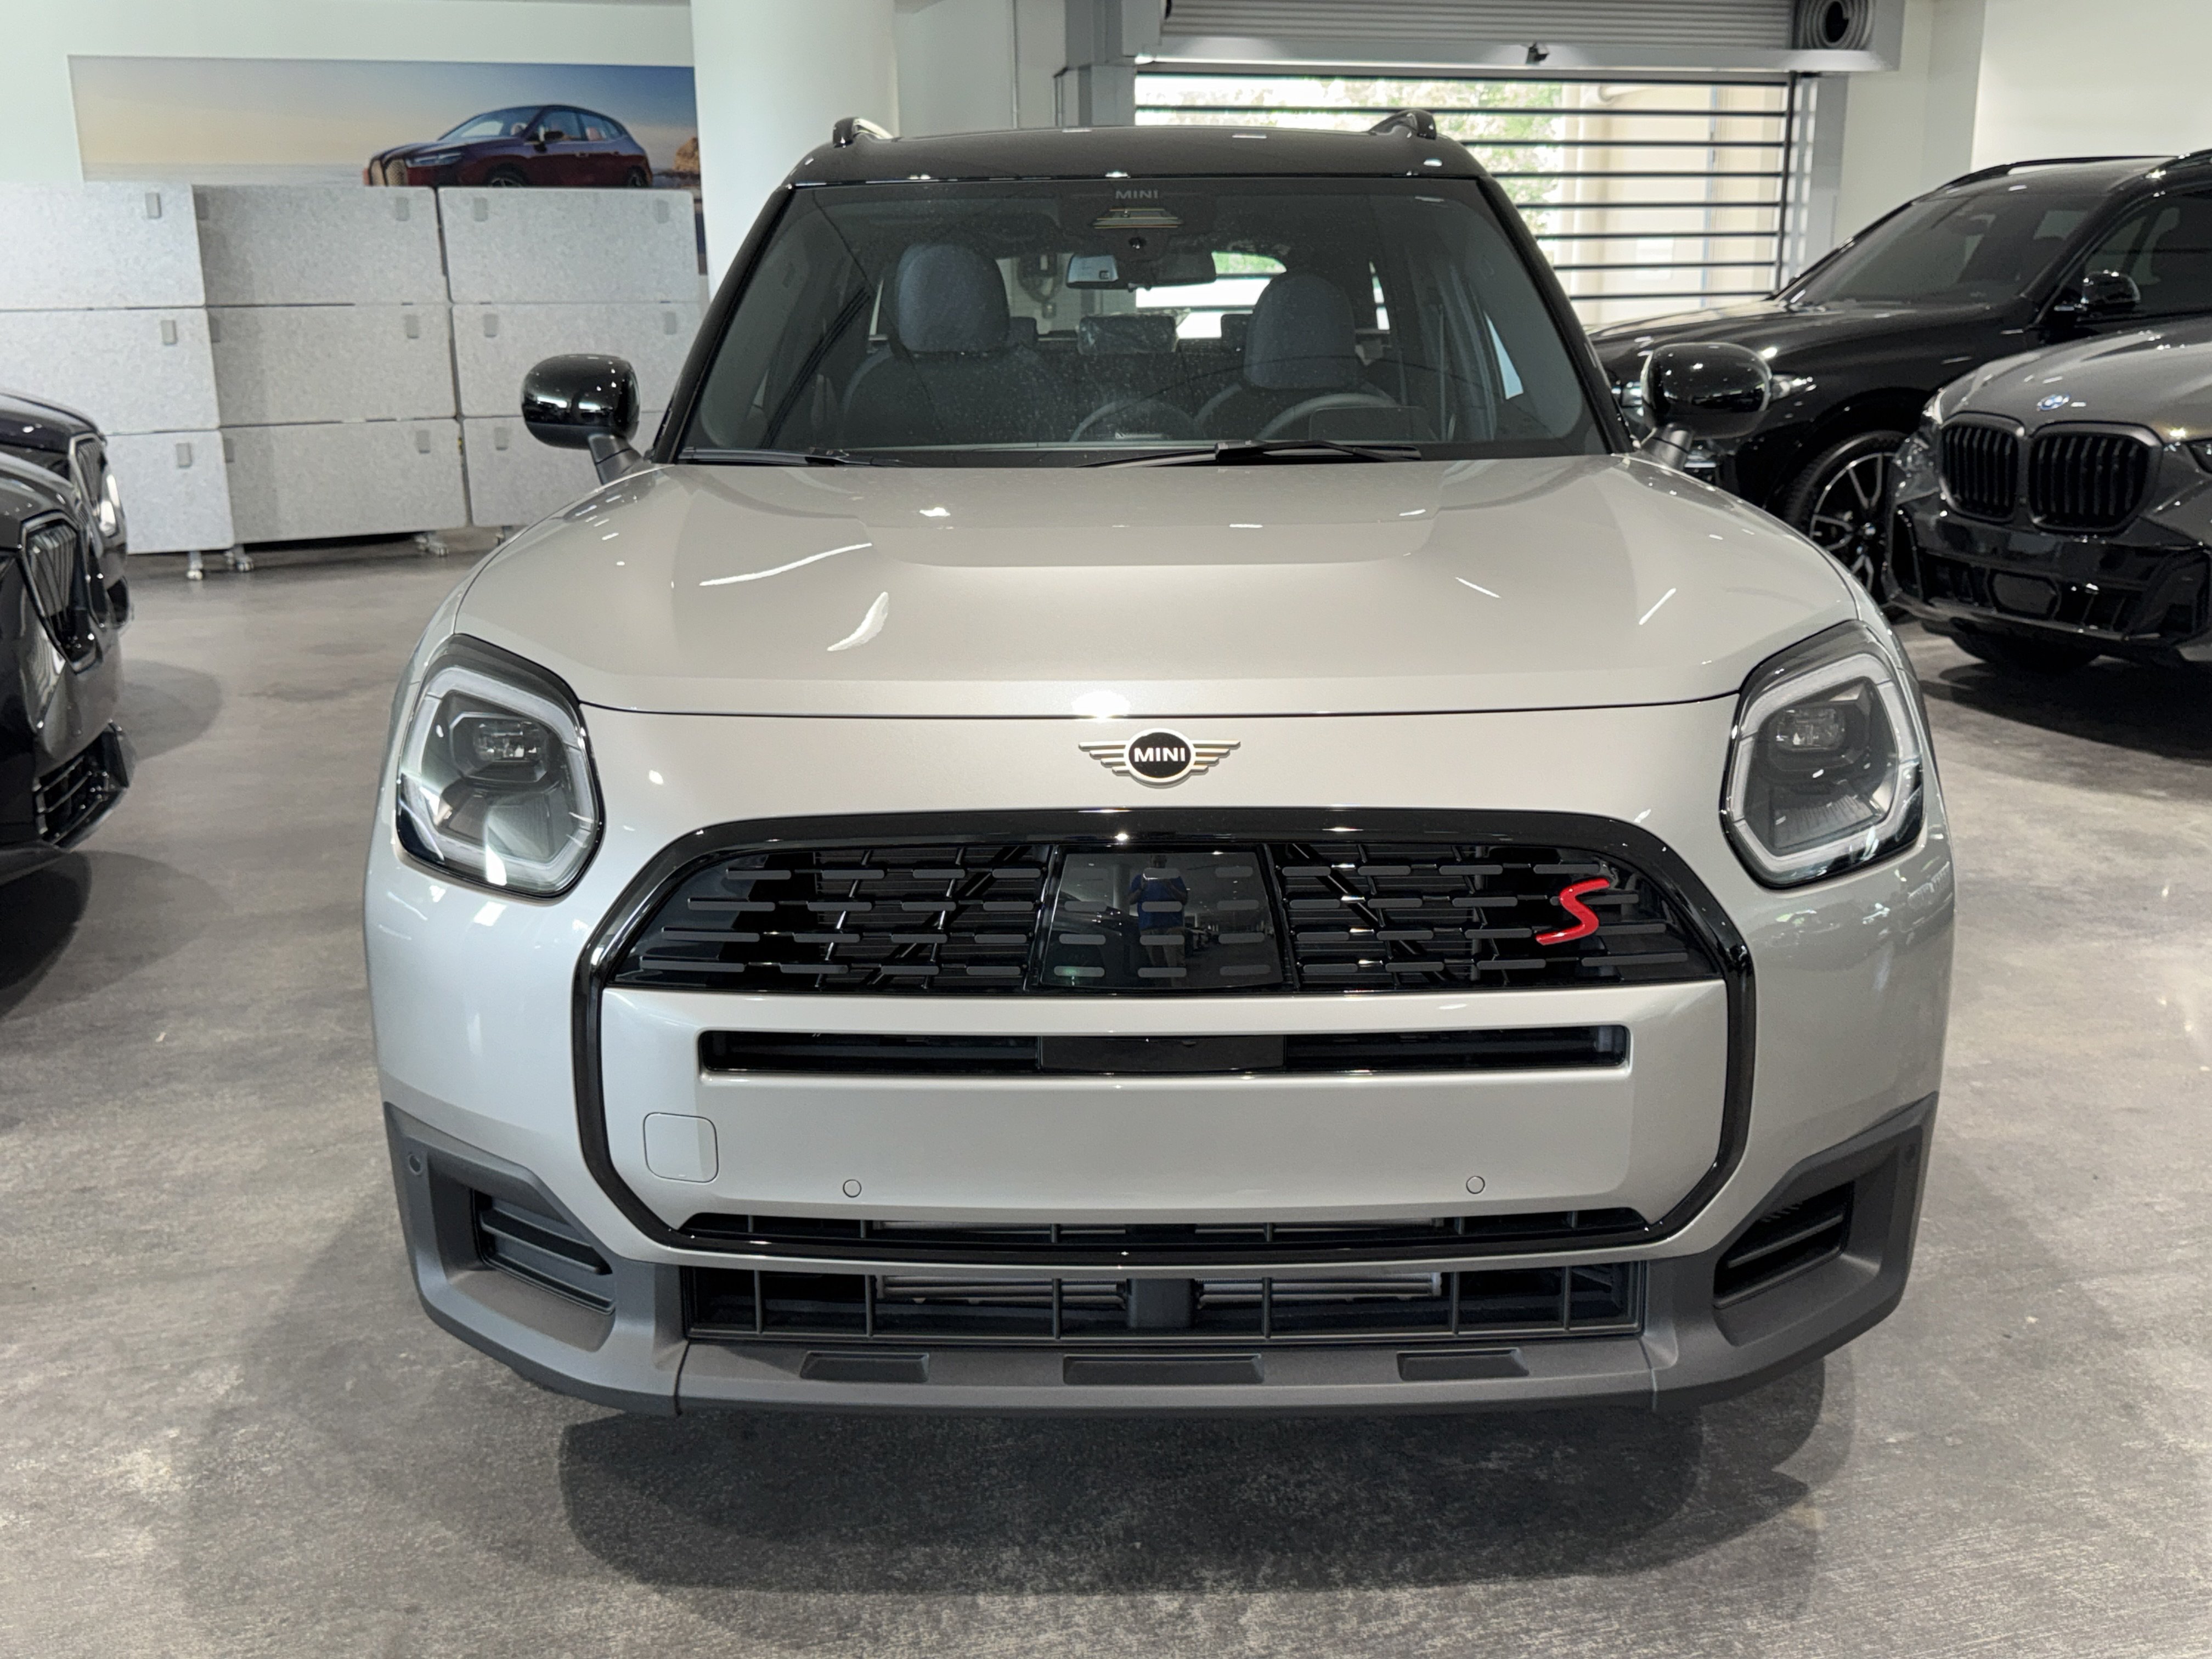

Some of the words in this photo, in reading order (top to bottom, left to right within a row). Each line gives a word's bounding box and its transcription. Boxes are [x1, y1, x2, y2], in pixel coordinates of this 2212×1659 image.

[1114, 190, 1159, 199] MINI
[1134, 747, 1186, 763] MINI
[1536, 878, 1610, 945] S
